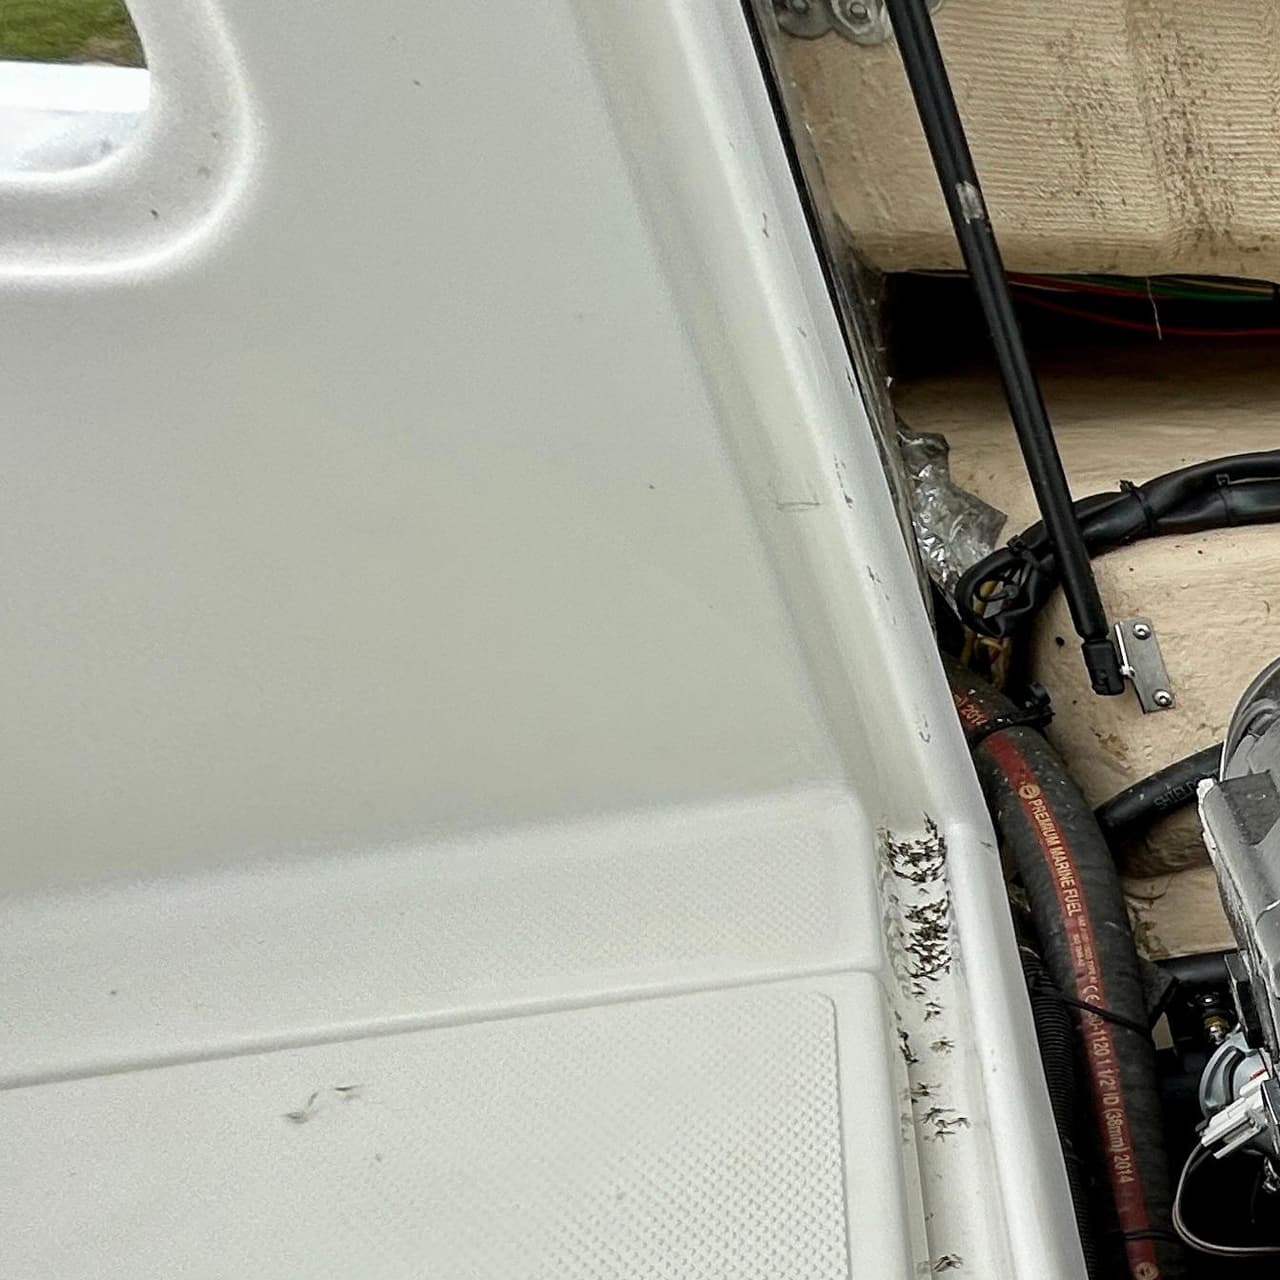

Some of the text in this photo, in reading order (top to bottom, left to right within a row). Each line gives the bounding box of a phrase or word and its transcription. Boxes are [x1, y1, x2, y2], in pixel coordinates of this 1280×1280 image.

[1028, 798, 1061, 847] PREMIUM
[1050, 846, 1076, 886] MARINE
[1063, 884, 1081, 916] FUEL
